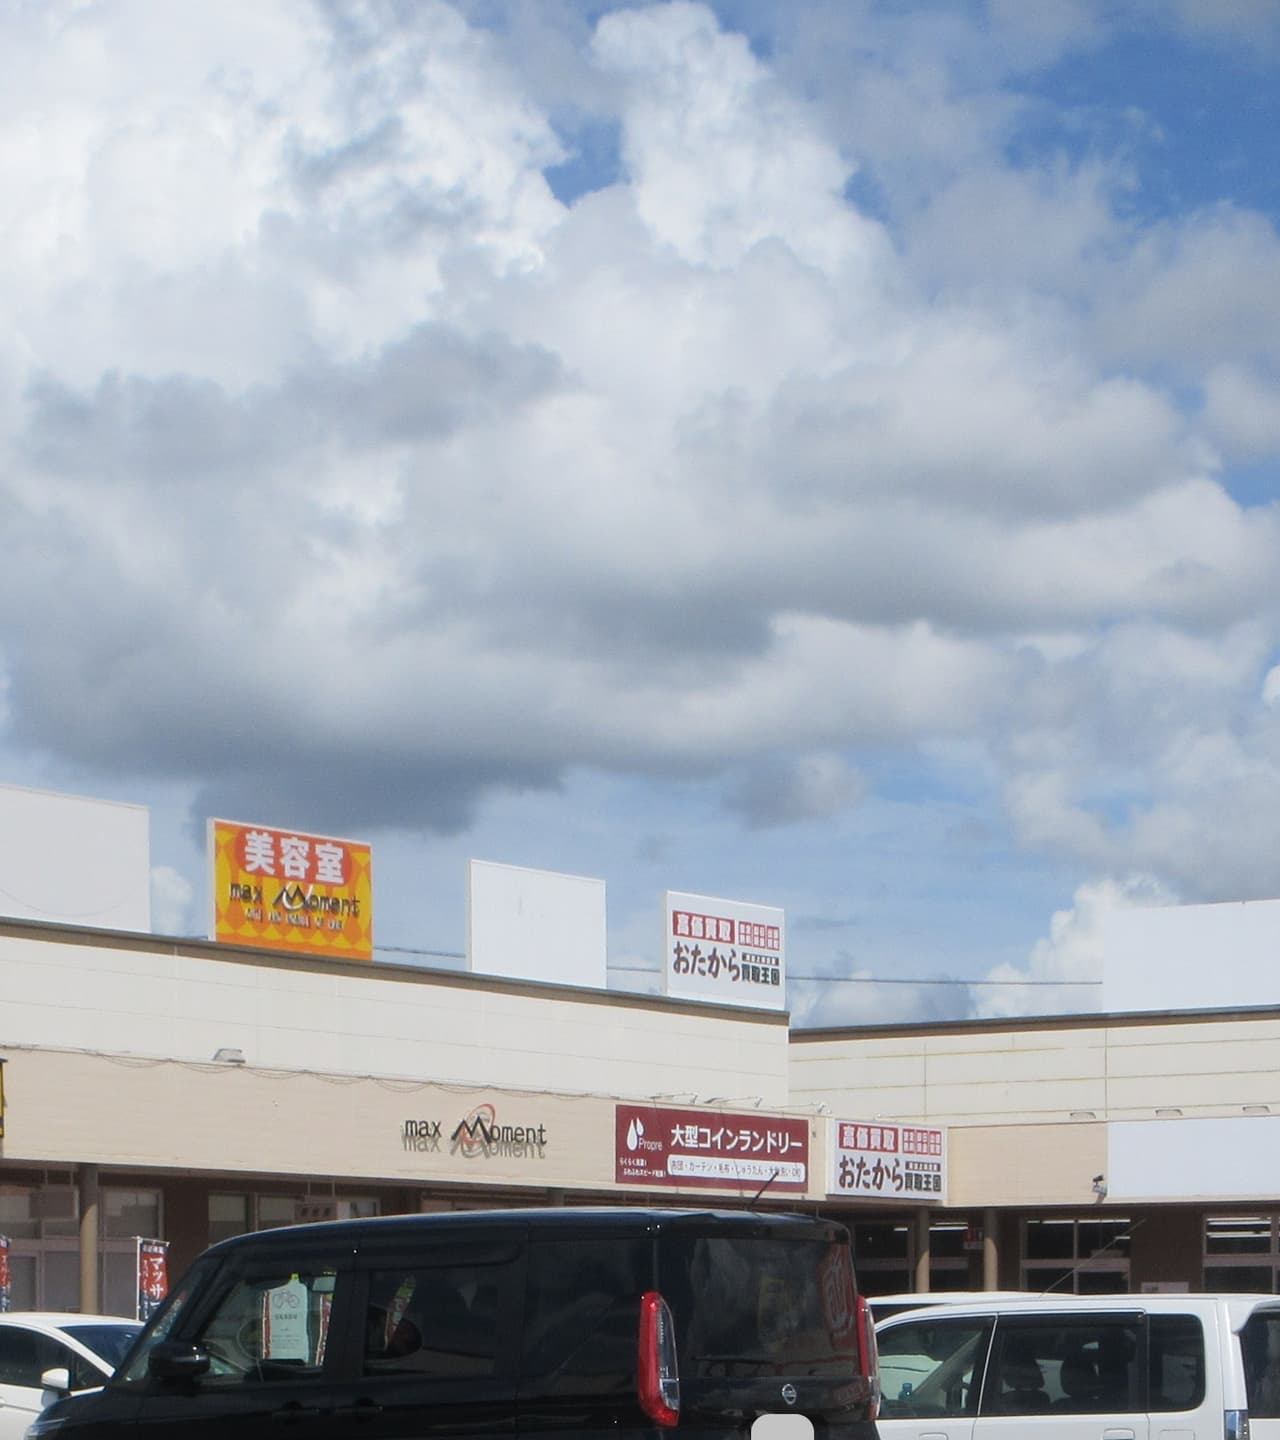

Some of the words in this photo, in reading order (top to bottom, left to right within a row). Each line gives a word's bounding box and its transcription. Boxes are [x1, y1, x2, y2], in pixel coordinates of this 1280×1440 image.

[244, 830, 345, 885] 美容室
[229, 882, 262, 904] max
[272, 884, 360, 917] Moment
[673, 941, 740, 982] おたから
[405, 1119, 442, 1137] max
[451, 1115, 548, 1145] Moment
[671, 1124, 803, 1154] 大型コインランドリー
[839, 1154, 904, 1192] おたから
